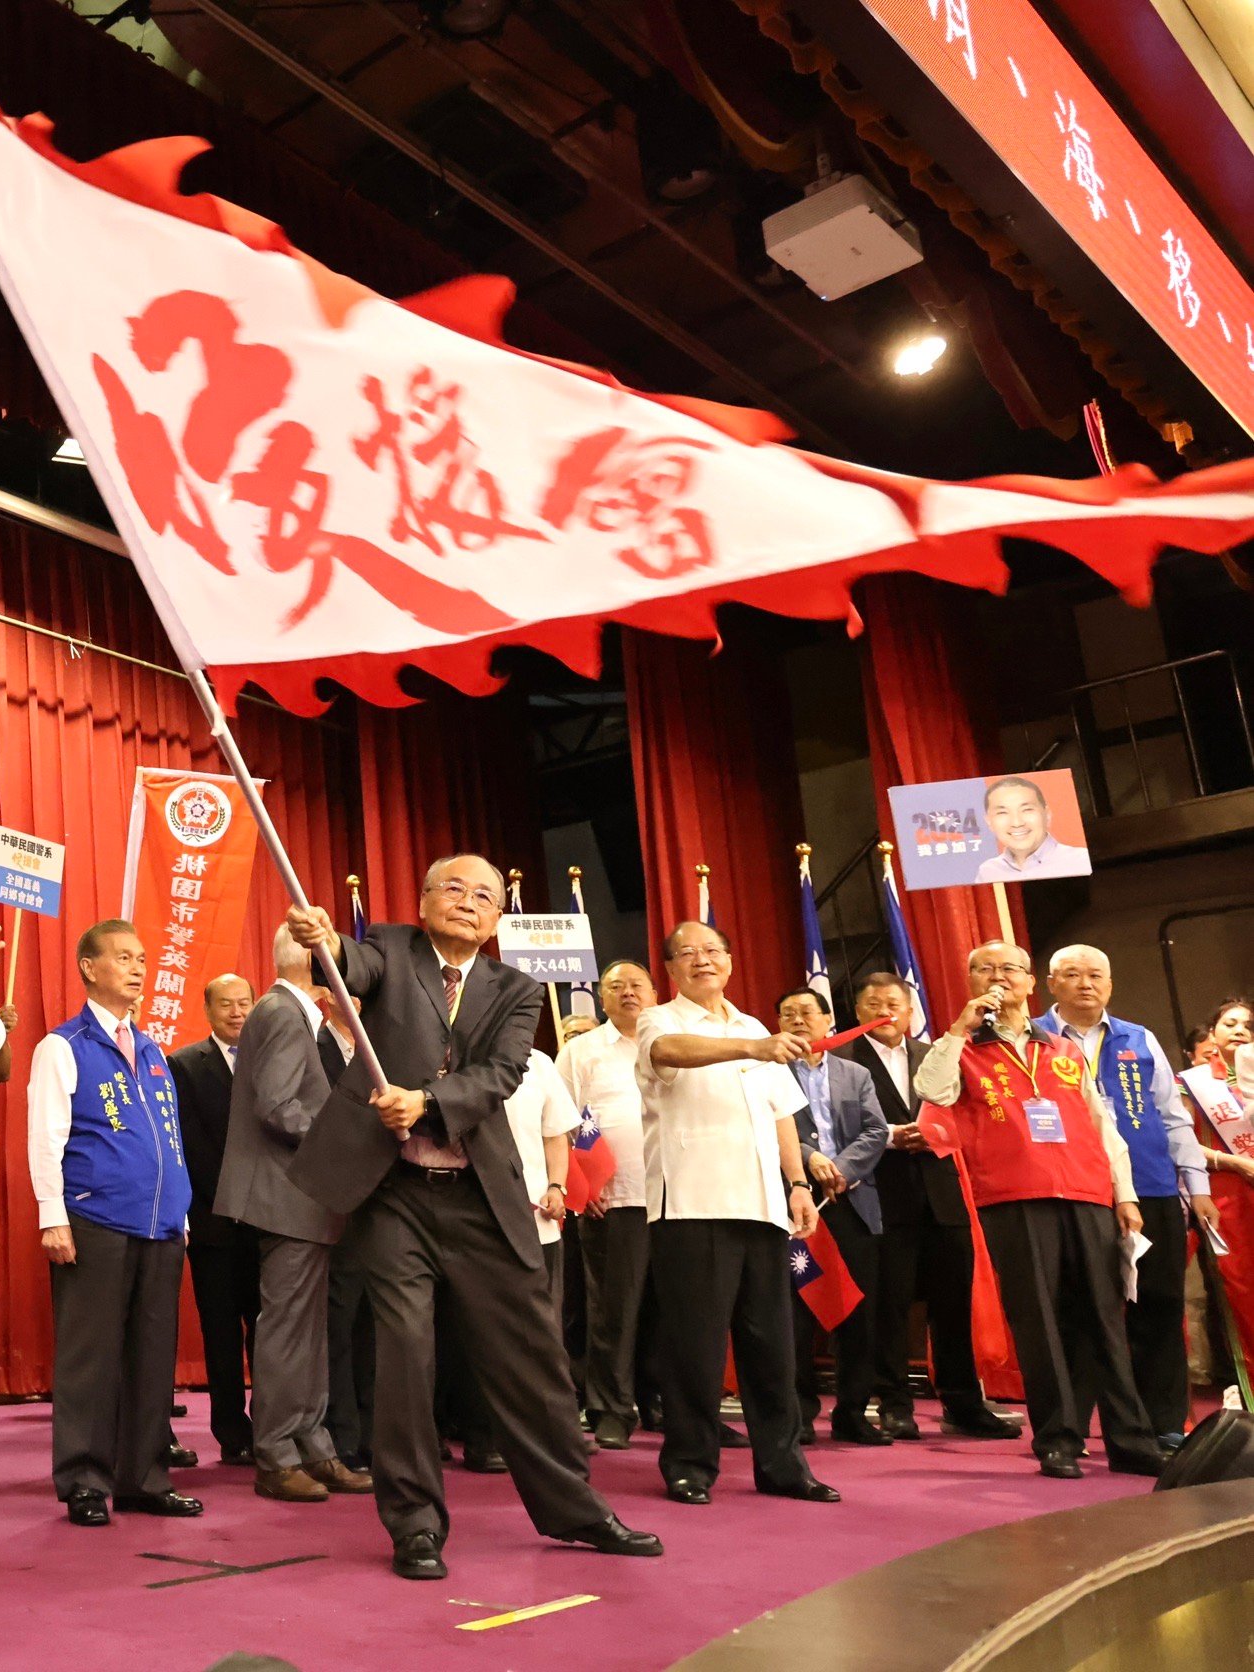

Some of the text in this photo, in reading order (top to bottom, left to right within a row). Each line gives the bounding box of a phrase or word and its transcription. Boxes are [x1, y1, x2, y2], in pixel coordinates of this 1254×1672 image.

[0, 833, 52, 859] 中華民國警系
[511, 919, 575, 930] 中華民國警系
[516, 956, 583, 974] 警大44期
